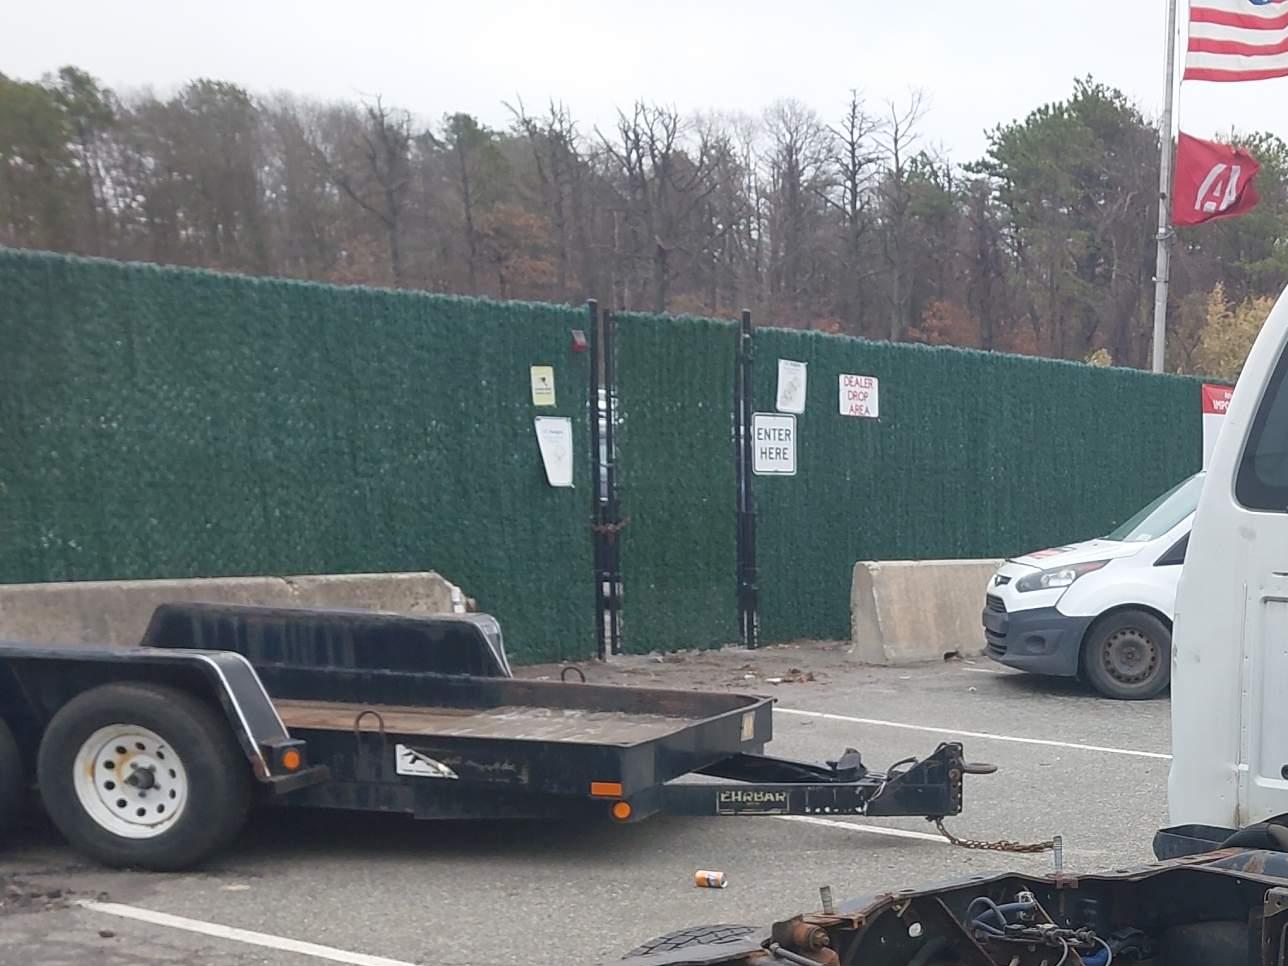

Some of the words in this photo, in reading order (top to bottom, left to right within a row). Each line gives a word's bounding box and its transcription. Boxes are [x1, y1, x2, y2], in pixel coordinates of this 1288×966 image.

[844, 375, 873, 389] DEALER
[847, 390, 869, 402] DROP
[848, 403, 871, 416] AREA
[756, 427, 792, 442] ENTER
[760, 447, 789, 461] HERE
